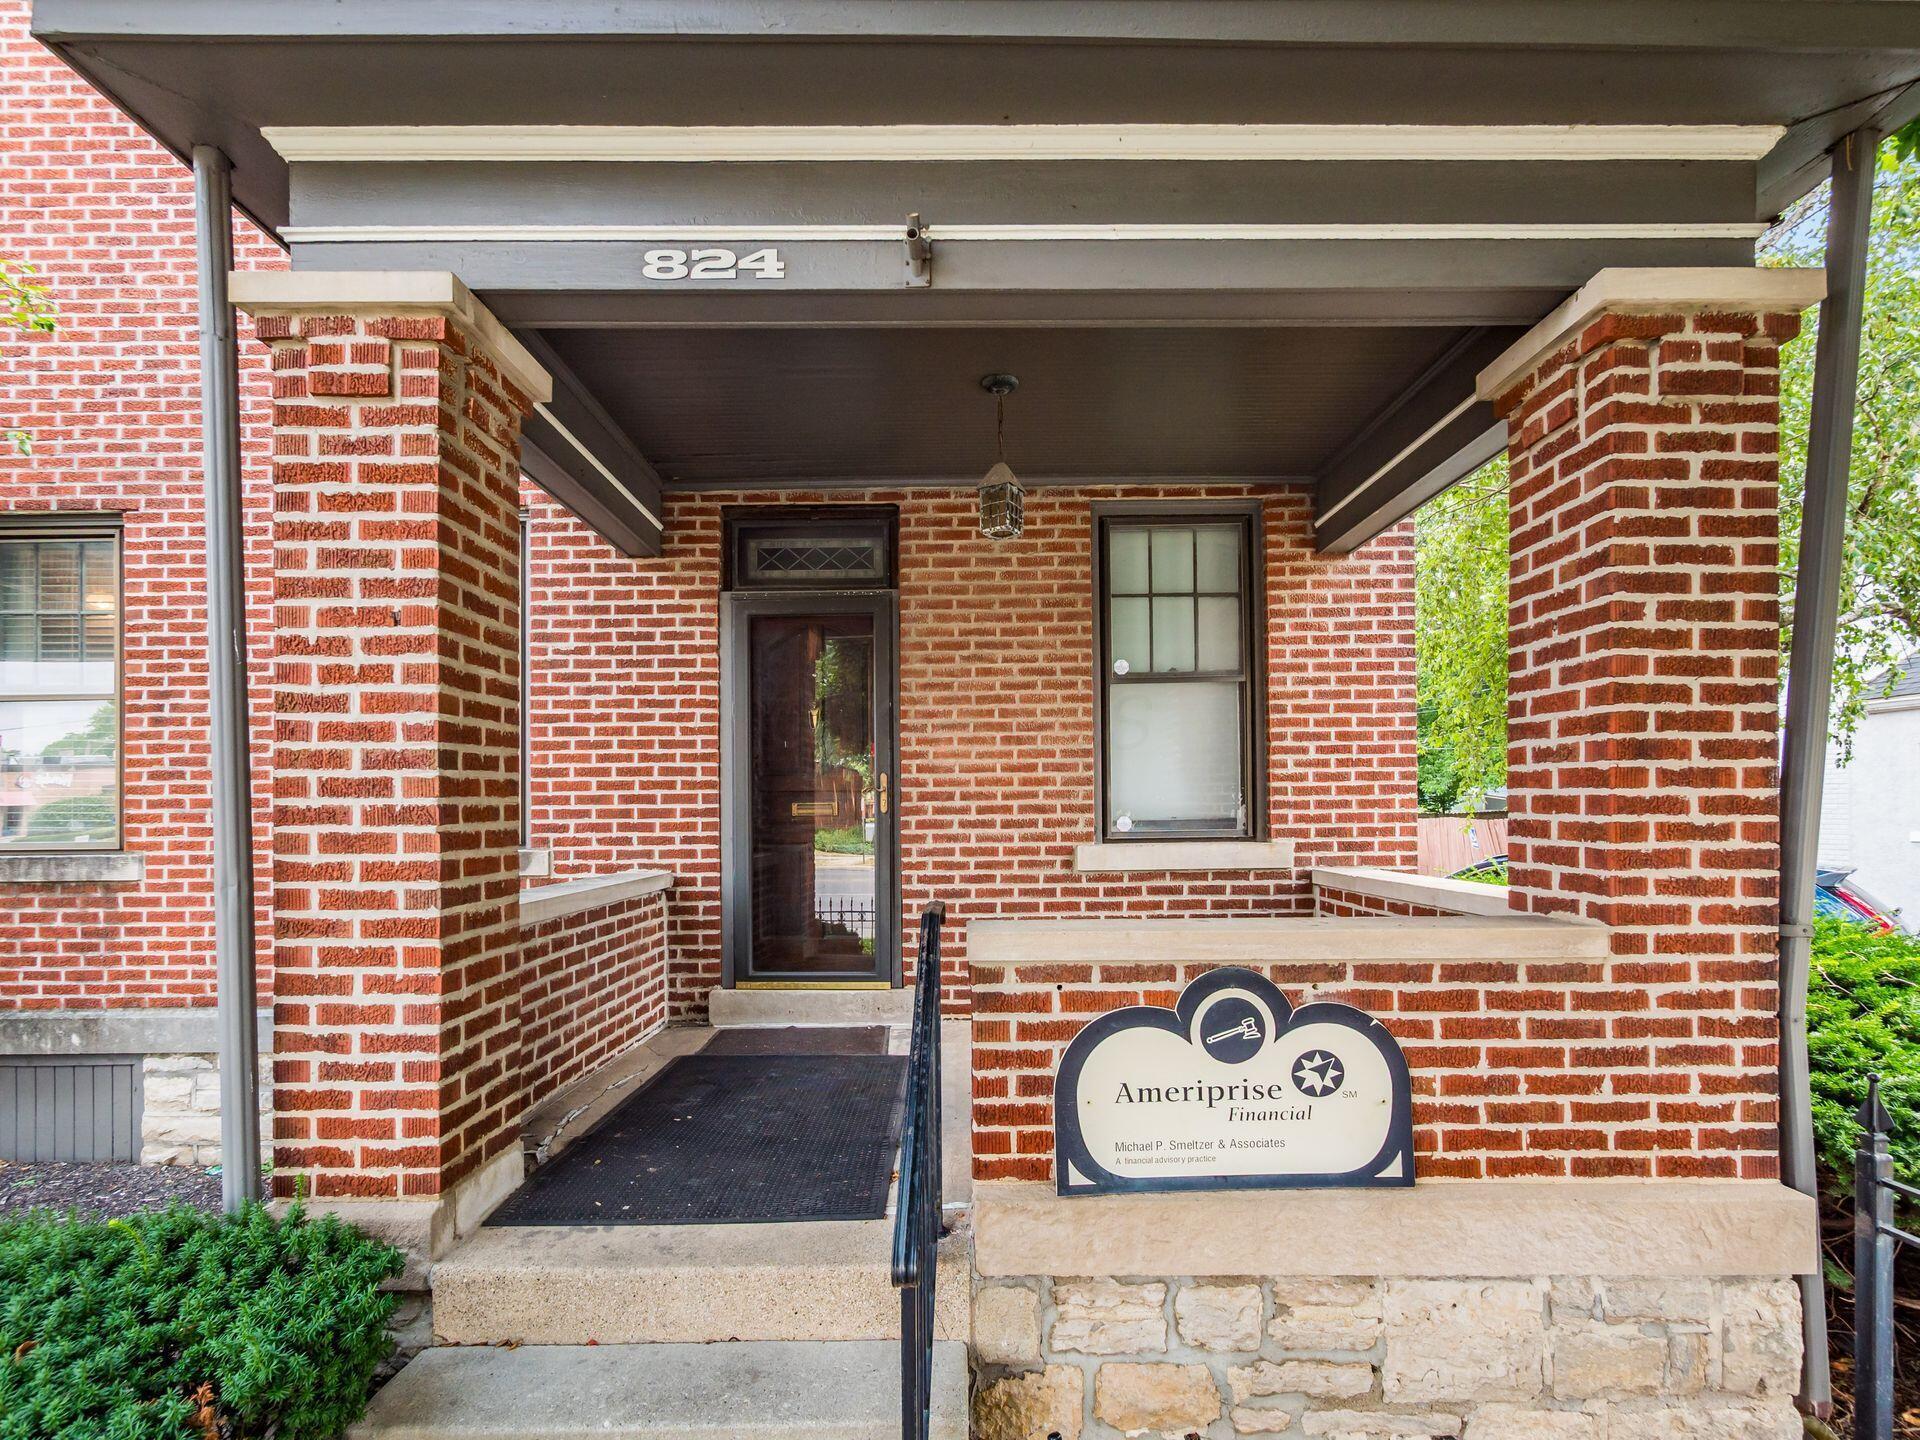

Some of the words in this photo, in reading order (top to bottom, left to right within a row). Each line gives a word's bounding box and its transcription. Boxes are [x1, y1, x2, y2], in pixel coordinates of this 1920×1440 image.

[642, 249, 785, 280] 824
[1115, 1078, 1283, 1108] Ameriprise
[1342, 1090, 1358, 1099] SM
[1228, 1105, 1312, 1122] Financial
[1115, 1141, 1153, 1152] Michael
[1156, 1140, 1166, 1151] P.
[1169, 1139, 1214, 1151] Smeltzer
[1218, 1138, 1226, 1149] &
[1230, 1137, 1286, 1149] Associates
[1115, 1157, 1122, 1165] A
[1124, 1156, 1154, 1165] financial
[1154, 1155, 1185, 1166] advisory
[1187, 1154, 1217, 1163] practice
